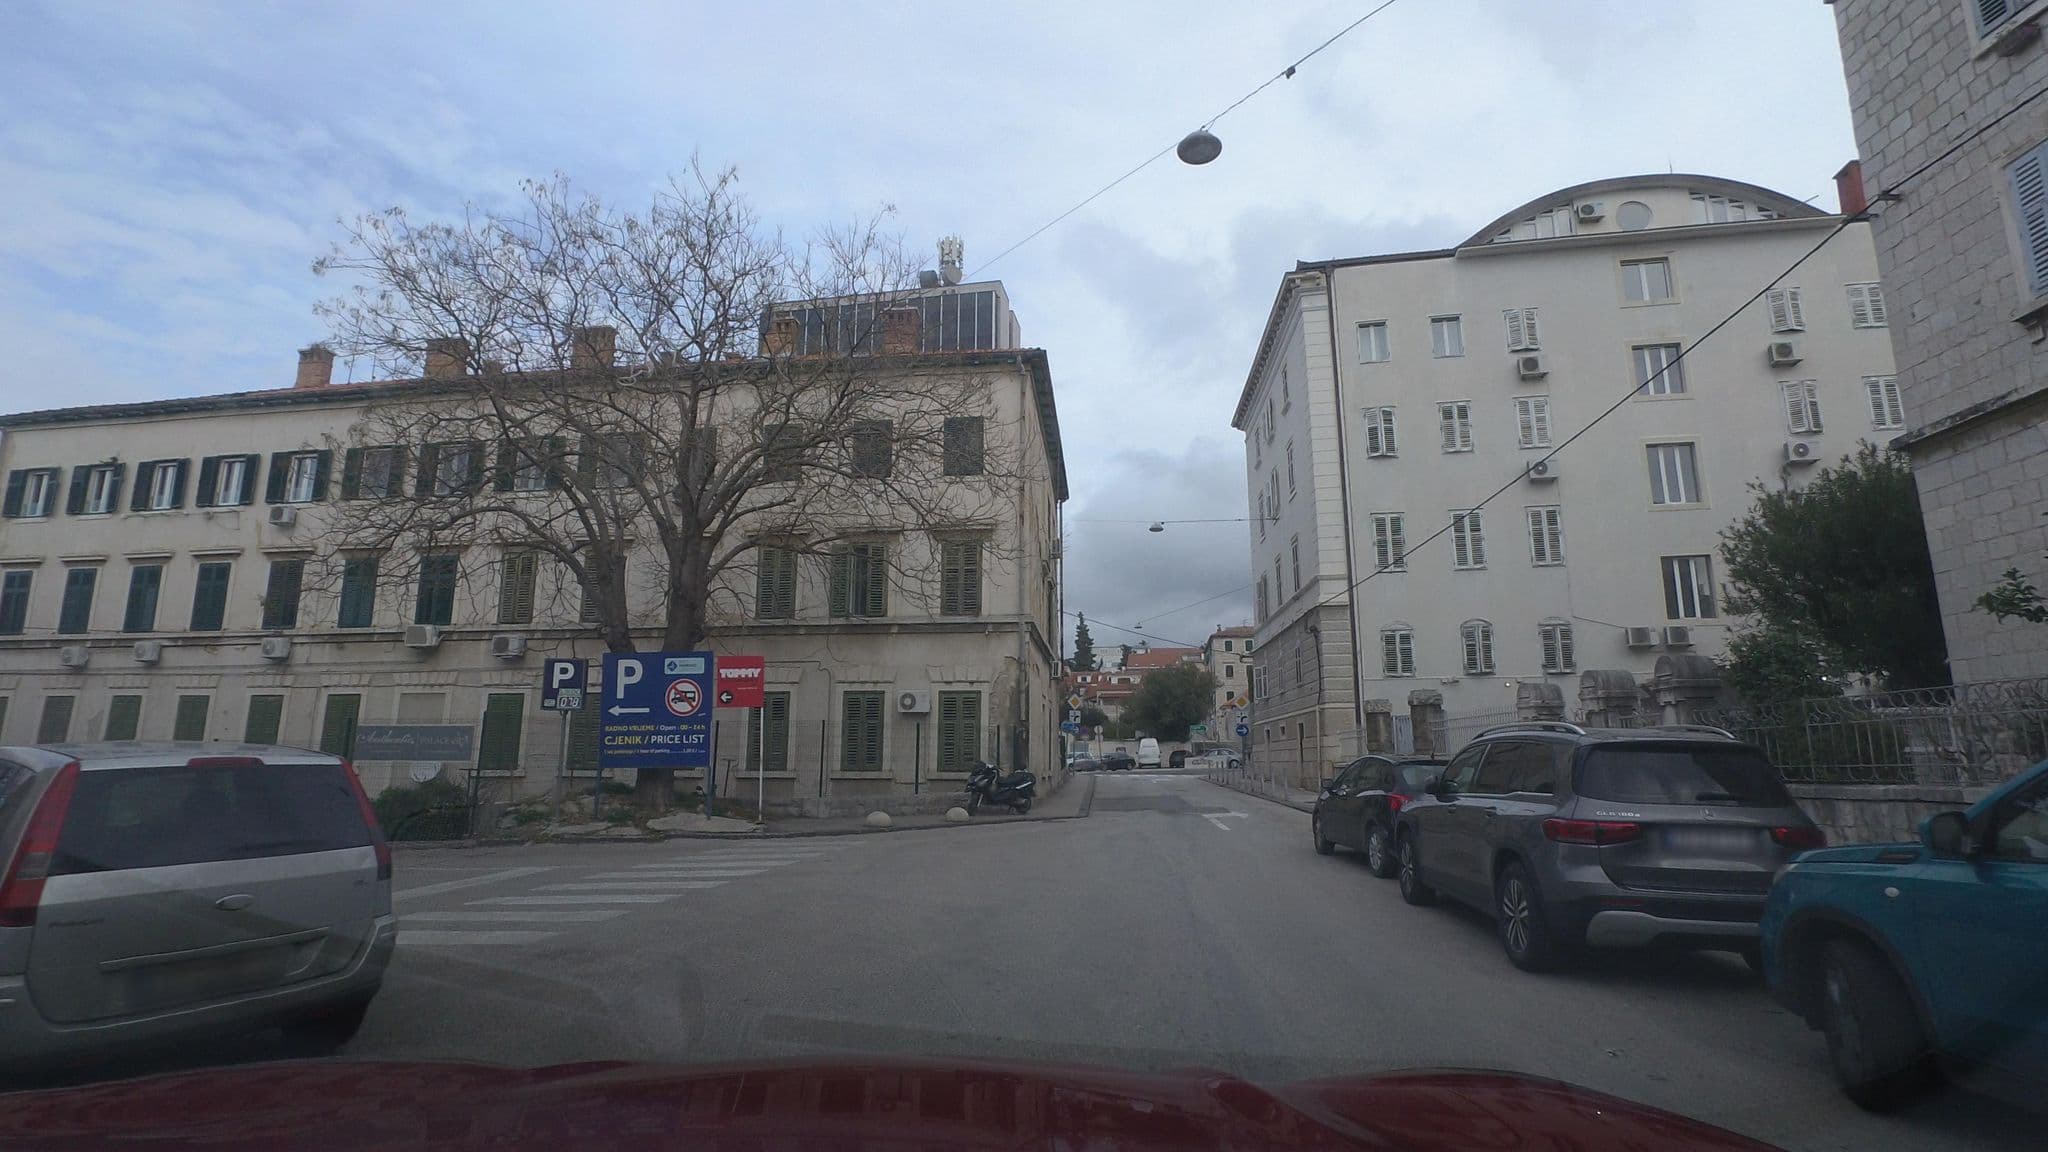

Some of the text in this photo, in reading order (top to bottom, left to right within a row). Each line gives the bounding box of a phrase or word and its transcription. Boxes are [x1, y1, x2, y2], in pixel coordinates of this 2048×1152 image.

[552, 662, 575, 689] P
[616, 659, 644, 699] P
[719, 668, 762, 678] TOMMY
[604, 735, 642, 745] CJENIK
[650, 734, 681, 743] PRICE
[682, 733, 705, 743] LIST
